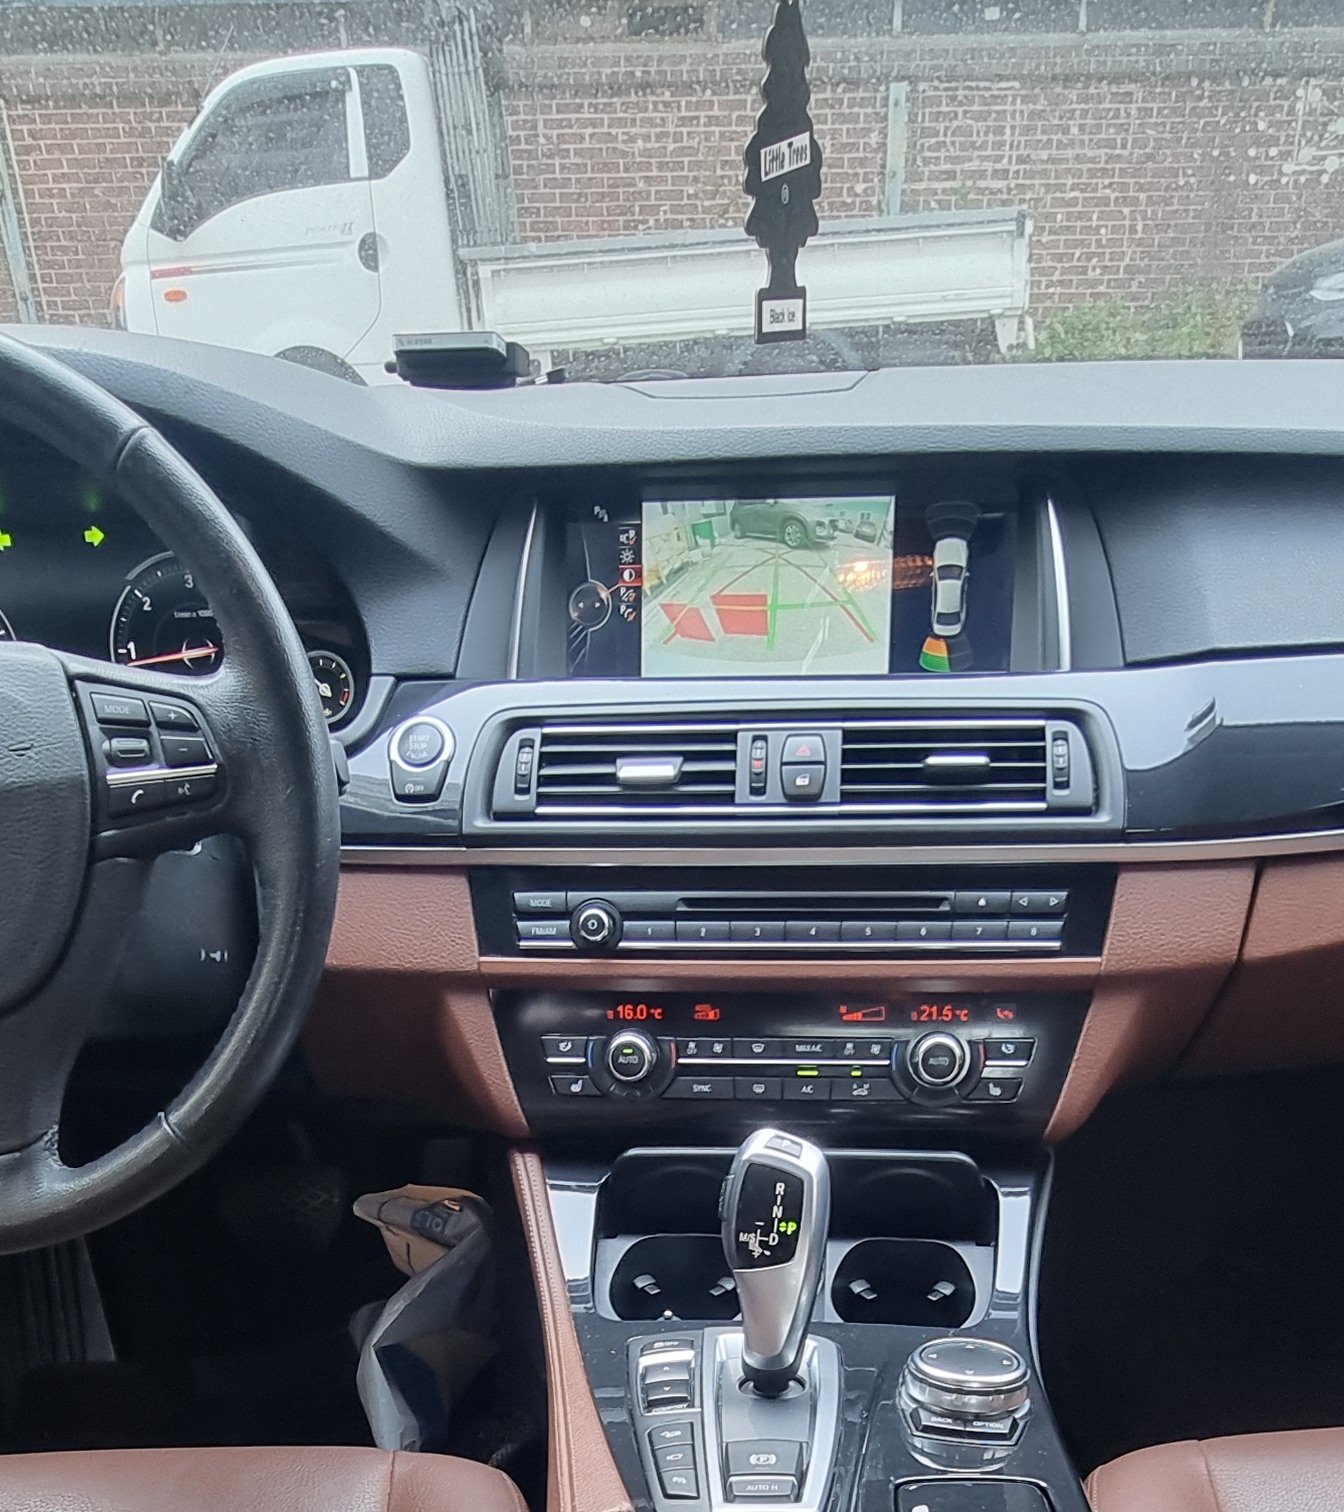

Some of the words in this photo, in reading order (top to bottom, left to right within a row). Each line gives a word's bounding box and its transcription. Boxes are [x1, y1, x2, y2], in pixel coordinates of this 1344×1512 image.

[764, 145, 785, 178] Little
[787, 141, 807, 167] Trees
[184, 574, 194, 588] 3
[141, 597, 152, 611] 2
[127, 641, 136, 660] 1
[104, 705, 131, 715] MODE
[529, 898, 552, 907] MODE
[647, 928, 652, 936] 1
[700, 928, 706, 936] 2
[754, 927, 760, 936] 3
[809, 927, 816, 936] 4
[865, 927, 872, 936] 5
[976, 927, 983, 936] 7
[617, 1005, 647, 1020] 16.0
[920, 1005, 953, 1022] 21.5
[618, 1056, 639, 1064] AUTO
[692, 1083, 712, 1093] SYNC
[775, 1182, 785, 1196] R
[772, 1205, 783, 1218] N
[787, 1221, 797, 1236] P
[768, 1233, 779, 1246] D
[745, 1484, 769, 1492] AUTO
[771, 1484, 778, 1492] H
